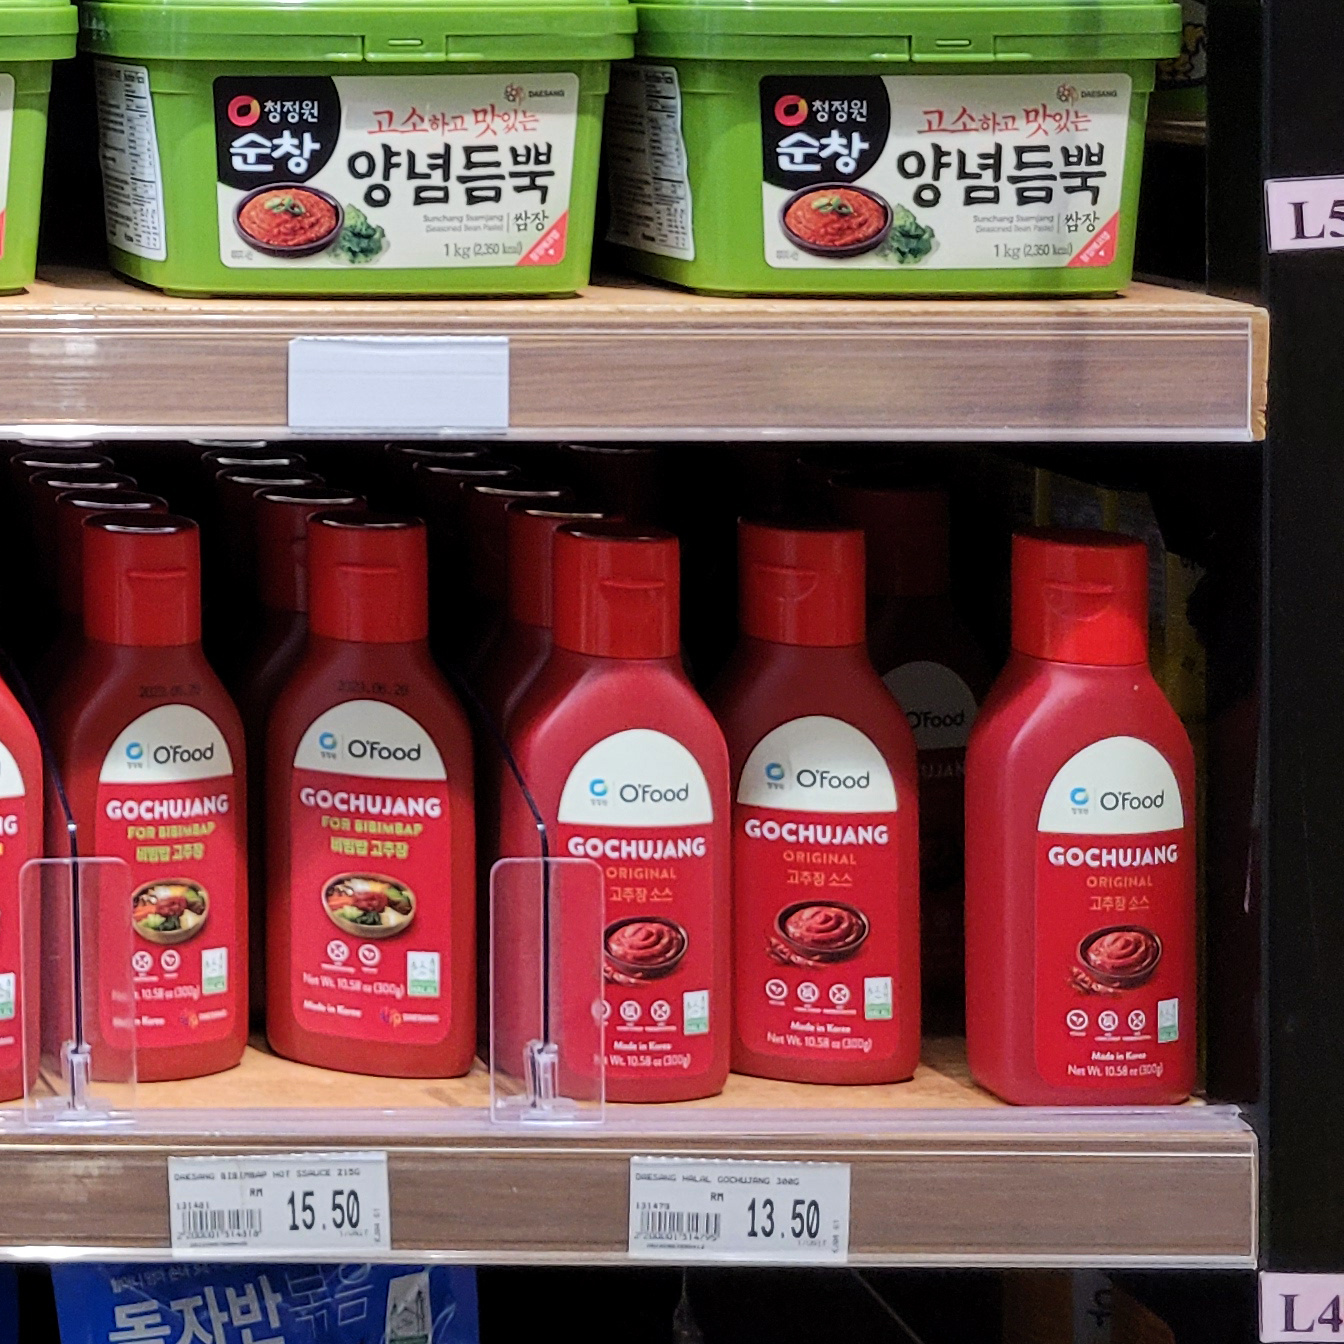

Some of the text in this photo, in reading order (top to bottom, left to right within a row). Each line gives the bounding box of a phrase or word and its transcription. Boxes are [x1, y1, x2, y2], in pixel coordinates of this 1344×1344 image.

[229, 130, 321, 175] 순창
[775, 129, 869, 175] 순창
[896, 141, 1108, 208] 양념듬뿍
[153, 742, 215, 766] O'Food
[796, 767, 871, 790] O'Food
[299, 787, 442, 819] GOCHUJANG
[744, 818, 889, 845] GOCHUJANG
[782, 849, 857, 866] ORIGINAL
[1048, 844, 1179, 868] GOCHUJANG
[286, 1189, 361, 1231] 15.50
[746, 1196, 821, 1240] 13.50
[1279, 1293, 1343, 1333] L4
